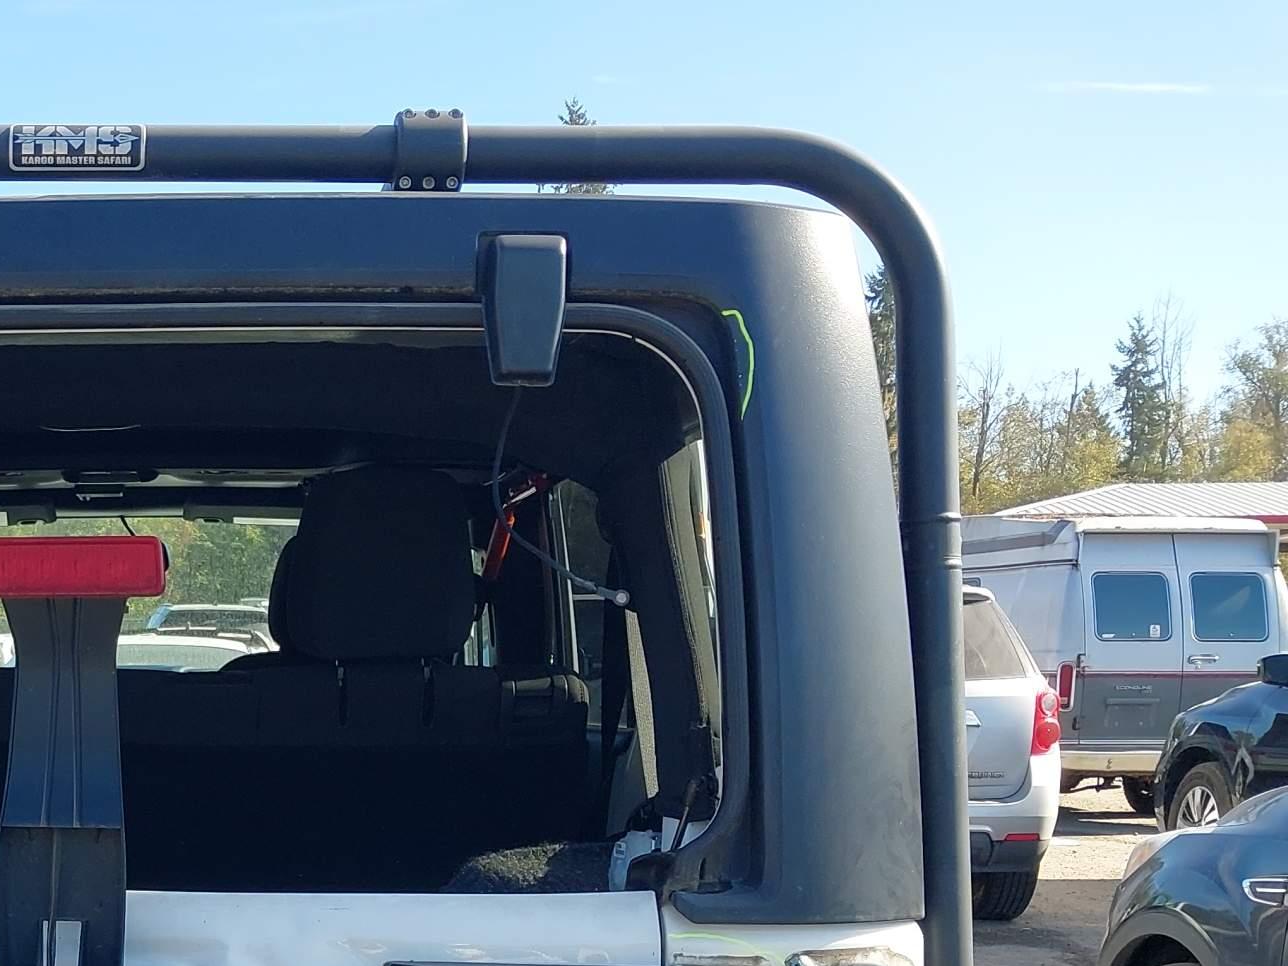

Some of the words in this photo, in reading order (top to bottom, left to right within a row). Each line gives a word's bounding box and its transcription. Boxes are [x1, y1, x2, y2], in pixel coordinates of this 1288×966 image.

[20, 125, 133, 155] KMS
[21, 156, 55, 165] KARGO
[56, 156, 96, 165] MASTER
[97, 156, 132, 165] SAFARI
